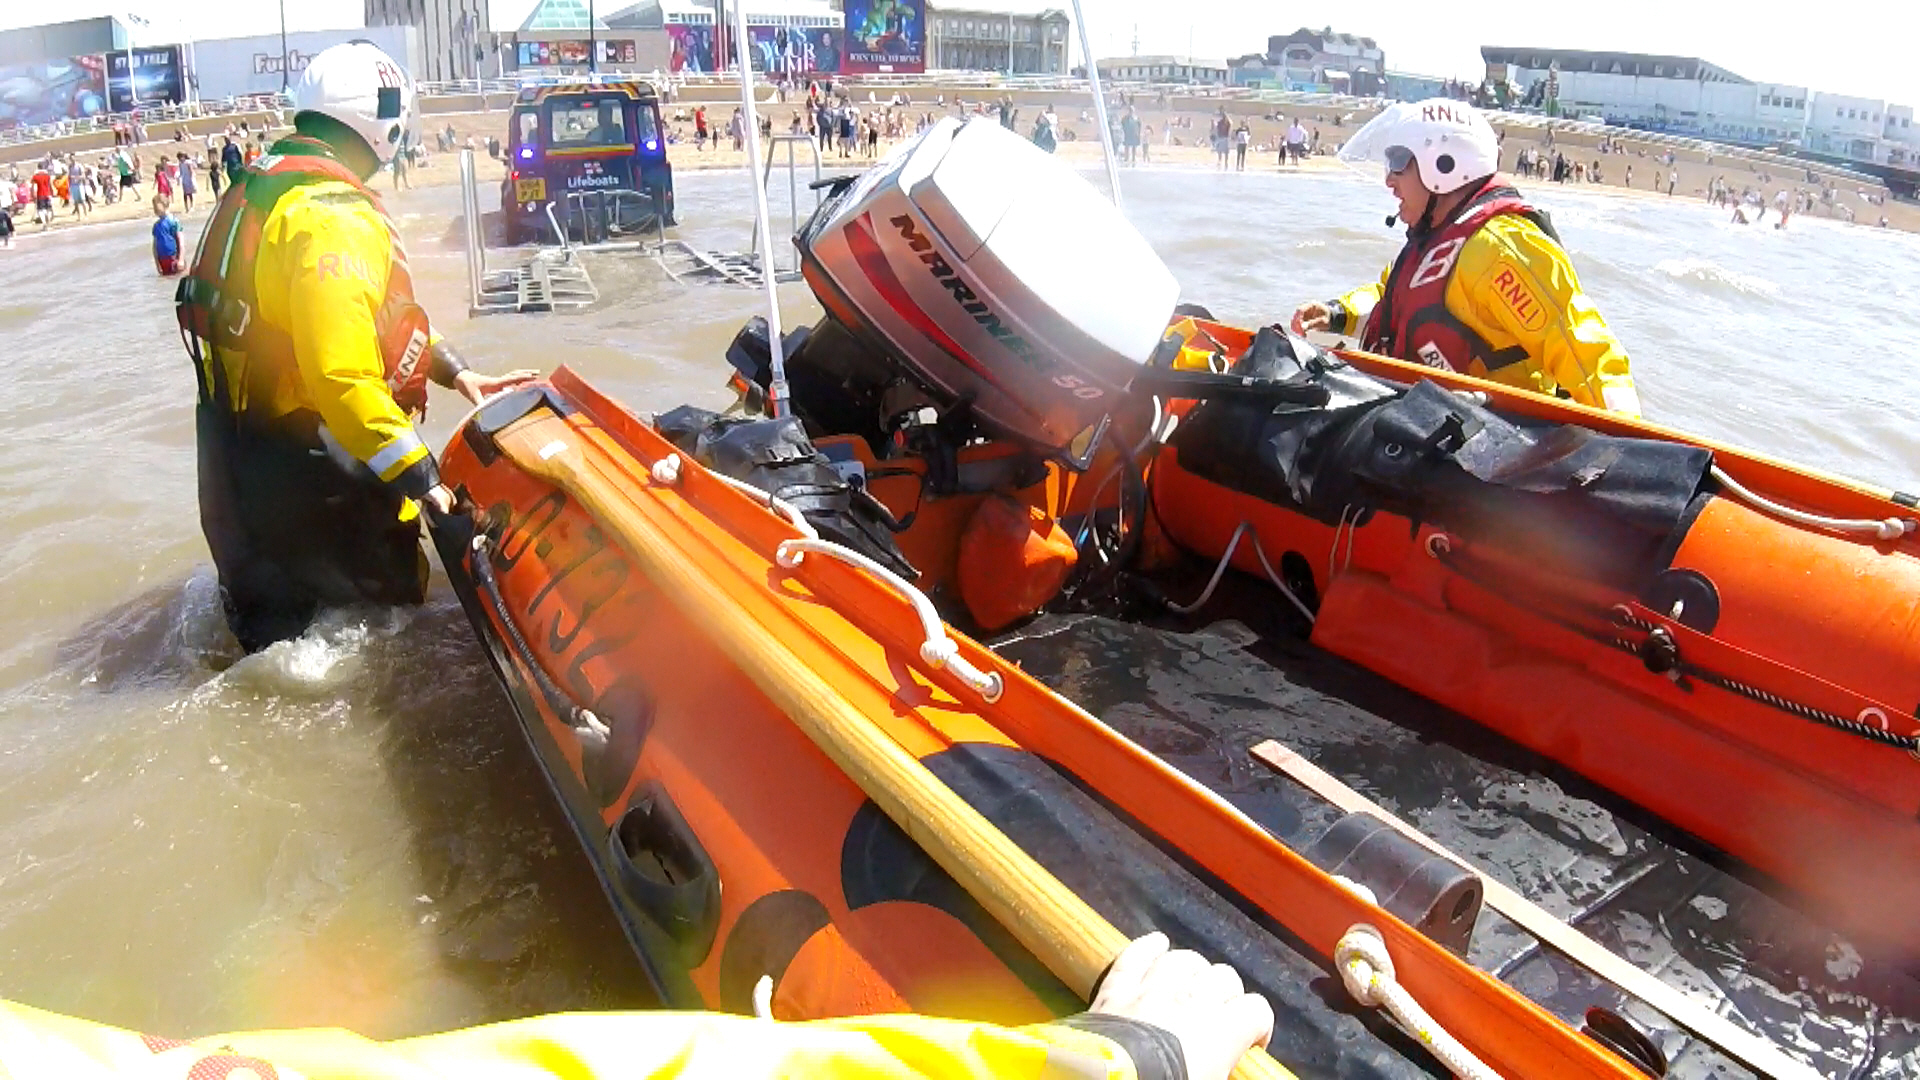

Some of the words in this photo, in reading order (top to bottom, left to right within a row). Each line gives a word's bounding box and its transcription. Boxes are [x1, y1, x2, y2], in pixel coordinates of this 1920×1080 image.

[1422, 105, 1471, 126] RNLI
[567, 175, 619, 188] Lifeboats
[1494, 270, 1541, 325] RNLI
[1051, 374, 1104, 399] 50
